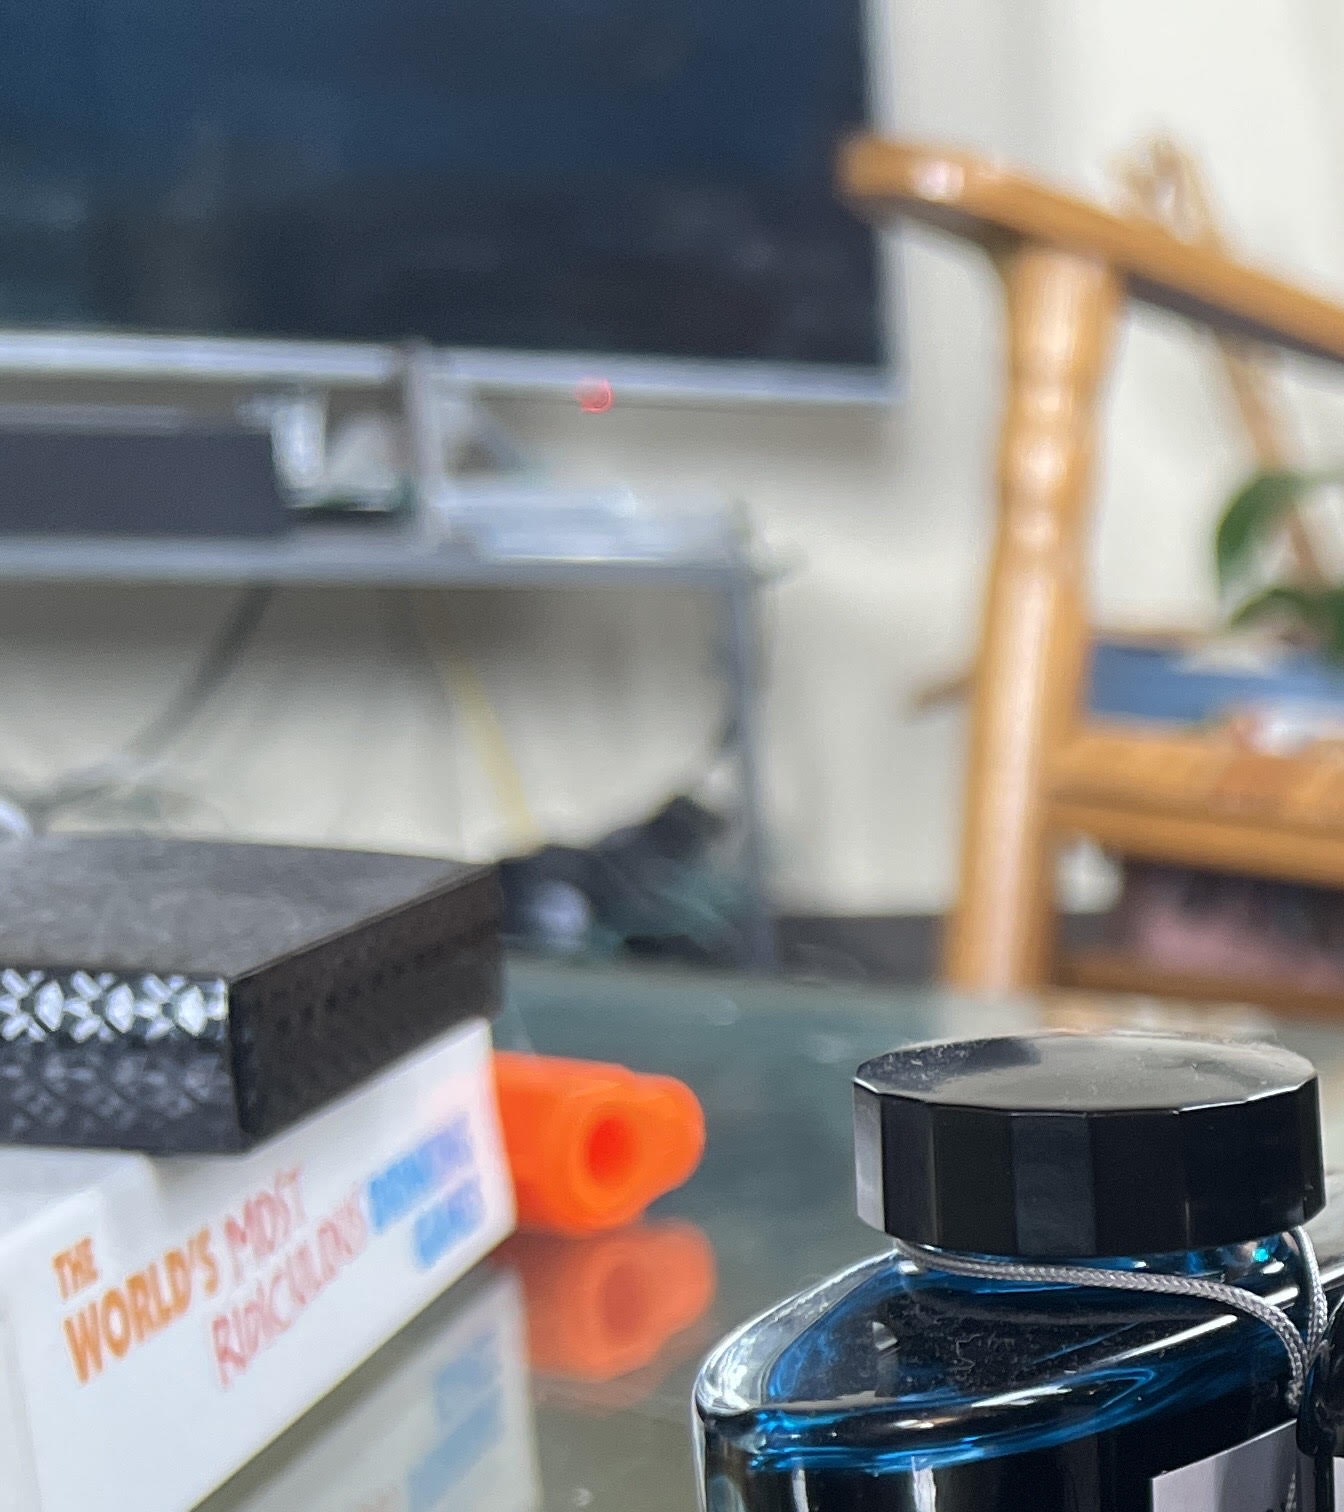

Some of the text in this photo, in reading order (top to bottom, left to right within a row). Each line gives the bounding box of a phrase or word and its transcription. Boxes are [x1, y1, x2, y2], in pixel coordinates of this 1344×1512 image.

[51, 1235, 100, 1300] THE
[63, 1226, 220, 1385] WORLD'S
[224, 1167, 307, 1284] MOST
